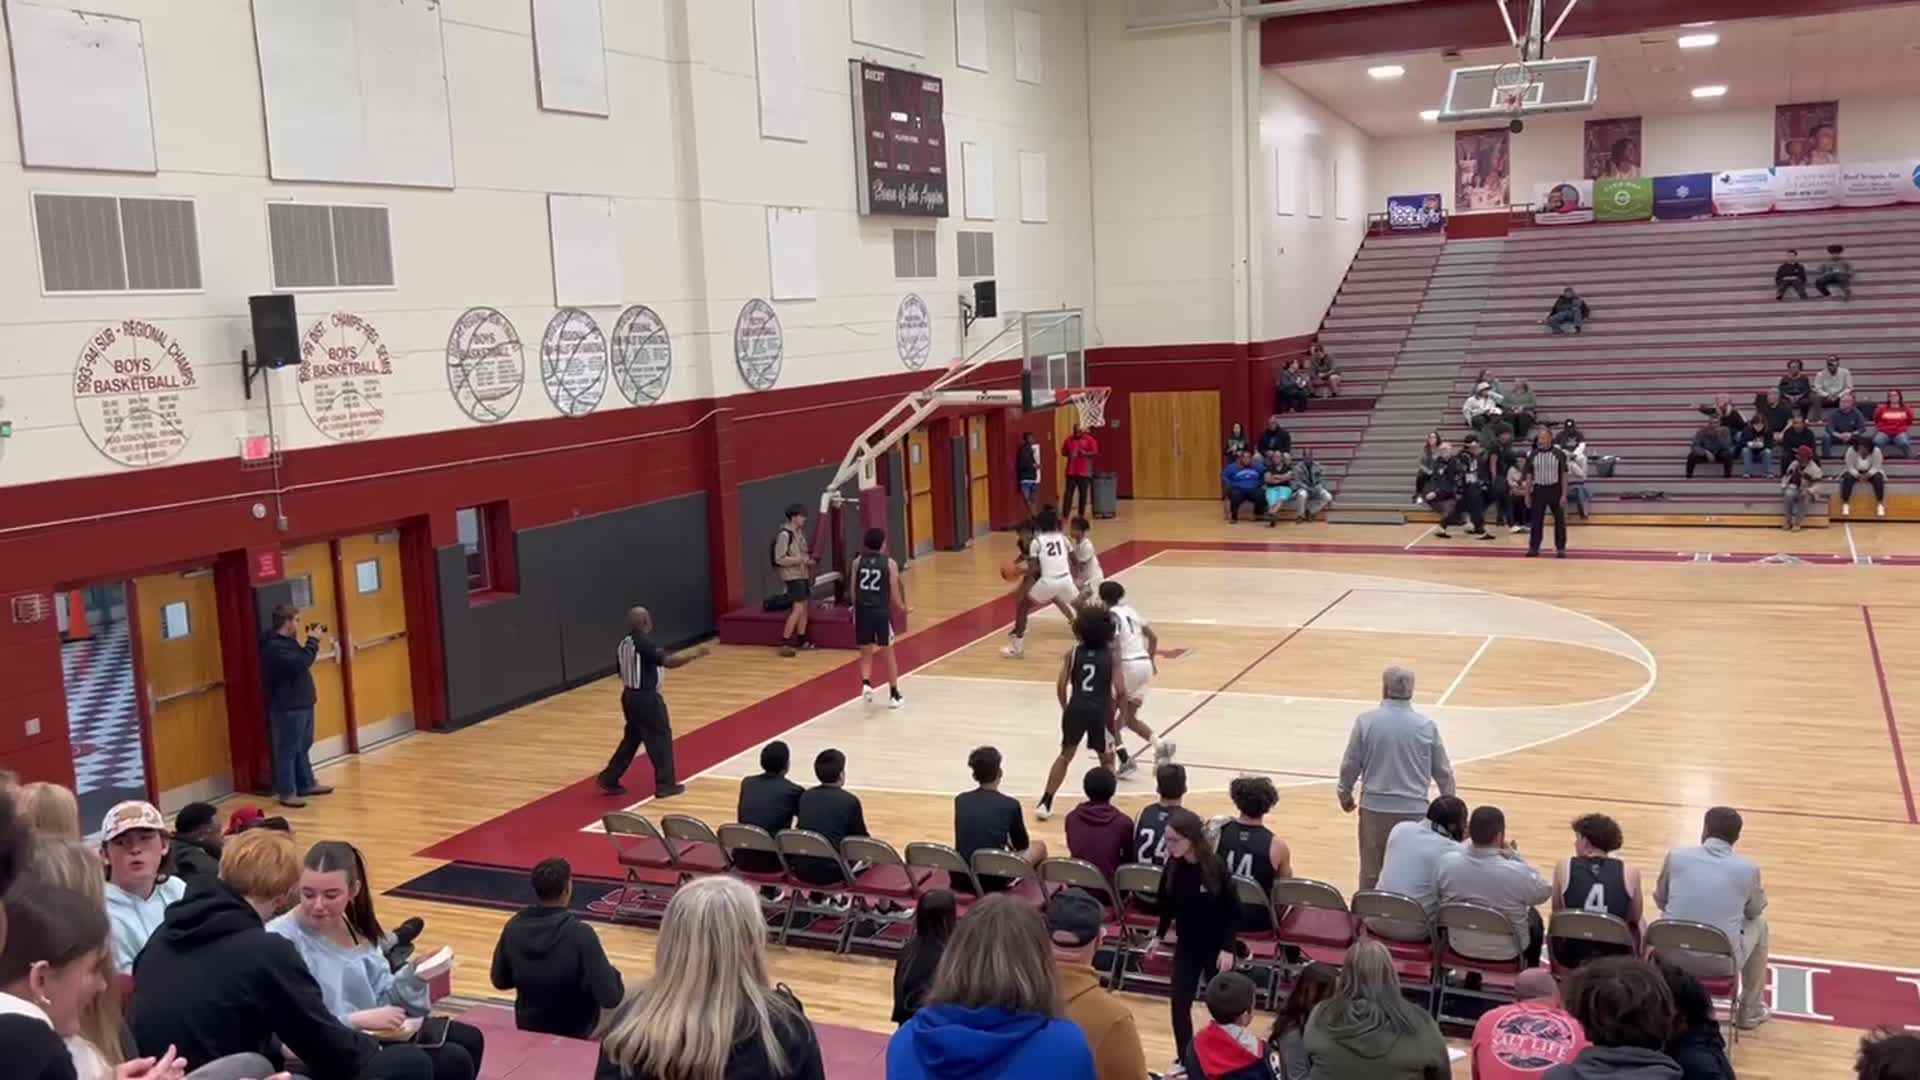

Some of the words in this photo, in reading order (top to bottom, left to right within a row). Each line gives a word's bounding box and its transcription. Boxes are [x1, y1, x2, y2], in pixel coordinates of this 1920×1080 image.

[95, 328, 115, 352] SUB
[122, 319, 169, 348] REGIONAL
[168, 342, 196, 386] CHAMPS
[328, 346, 358, 360] BOYS
[114, 358, 151, 374] BOYS
[313, 361, 379, 379] BASKETBALL
[94, 375, 180, 393] BASKETBALL
[1046, 542, 1062, 557] 21
[860, 568, 881, 591] 22
[1082, 664, 1096, 691] 2
[1584, 883, 1608, 913] 4
[1492, 1033, 1528, 1049] SALT
[1530, 1038, 1569, 1060] LIFE
